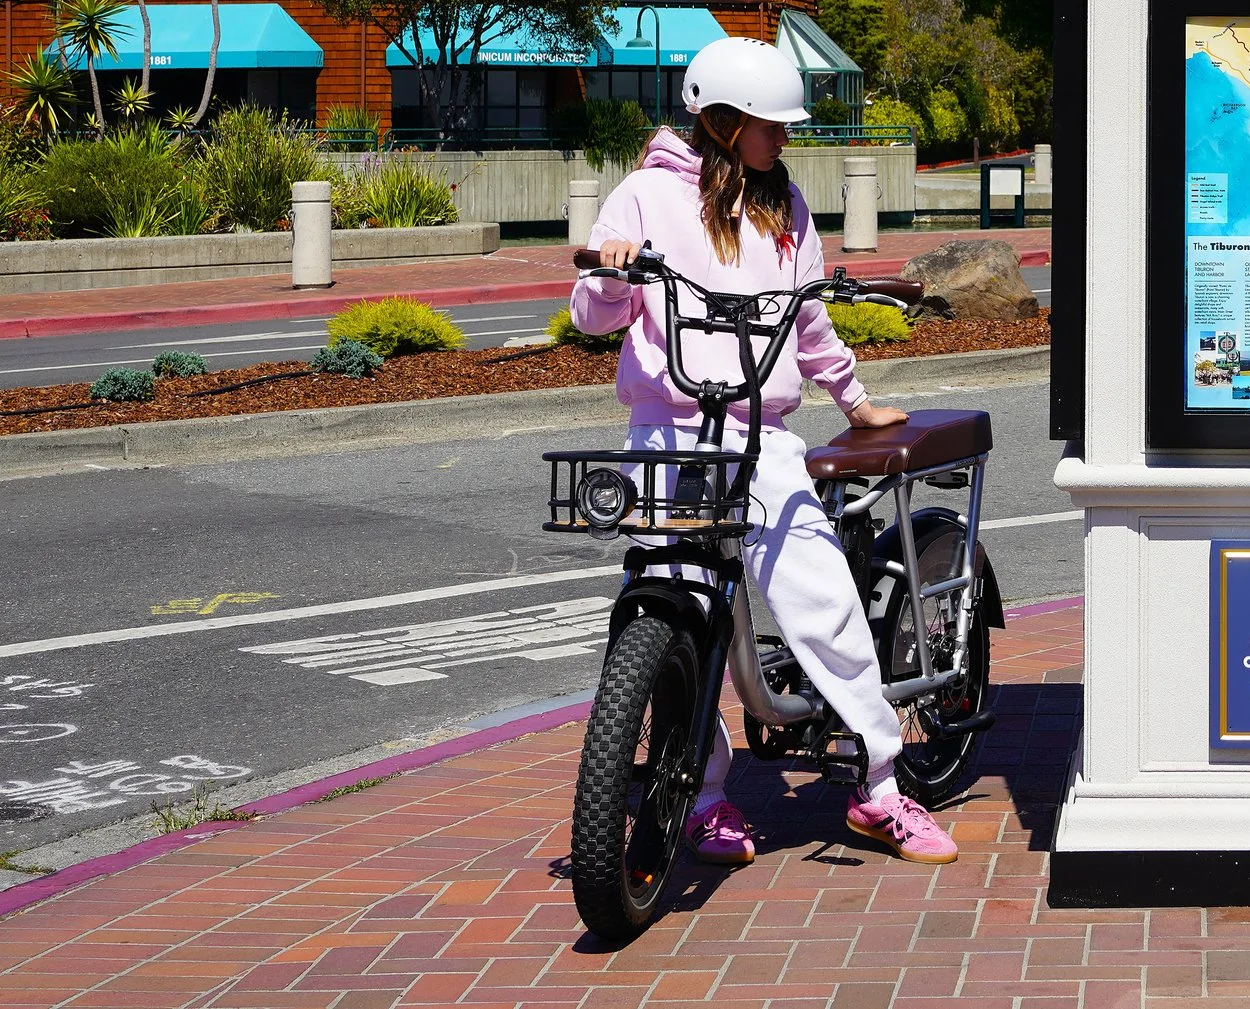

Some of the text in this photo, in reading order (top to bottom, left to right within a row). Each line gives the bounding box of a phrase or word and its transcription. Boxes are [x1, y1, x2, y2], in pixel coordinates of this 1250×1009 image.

[150, 56, 171, 65] 1881
[478, 53, 512, 62] INICUM
[670, 54, 687, 62] 1881
[1193, 242, 1208, 251] The
[1210, 242, 1250, 251] Tiburon
